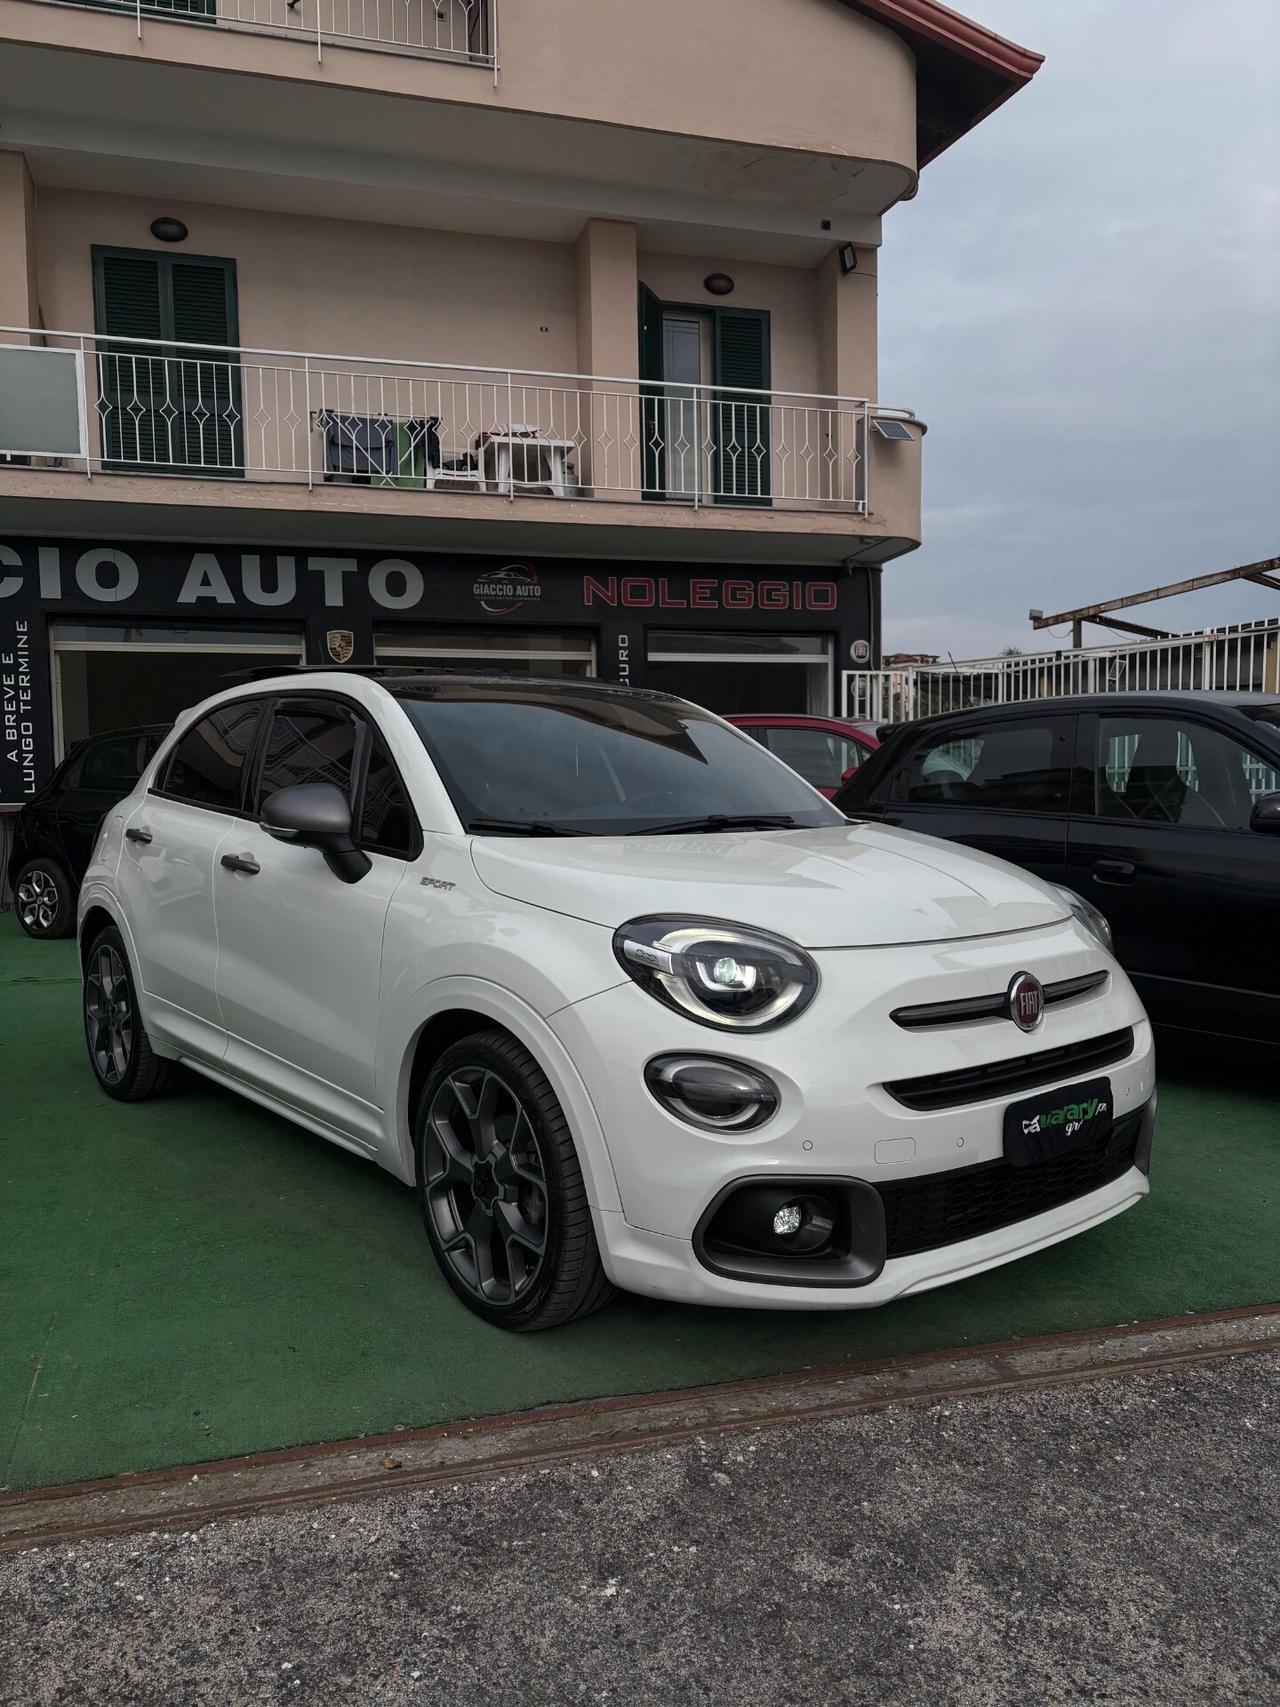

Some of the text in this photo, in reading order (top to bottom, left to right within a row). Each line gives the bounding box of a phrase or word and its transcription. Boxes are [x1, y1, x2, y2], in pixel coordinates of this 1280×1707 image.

[177, 552, 424, 610] AUTO
[473, 583, 541, 597] GIACCIO AUTO
[583, 575, 838, 611] NOLEGGIO
[2, 653, 19, 763] A BREVE E
[16, 620, 36, 793] LUNGO TERMINE
[1020, 991, 1039, 1017] FIAT
